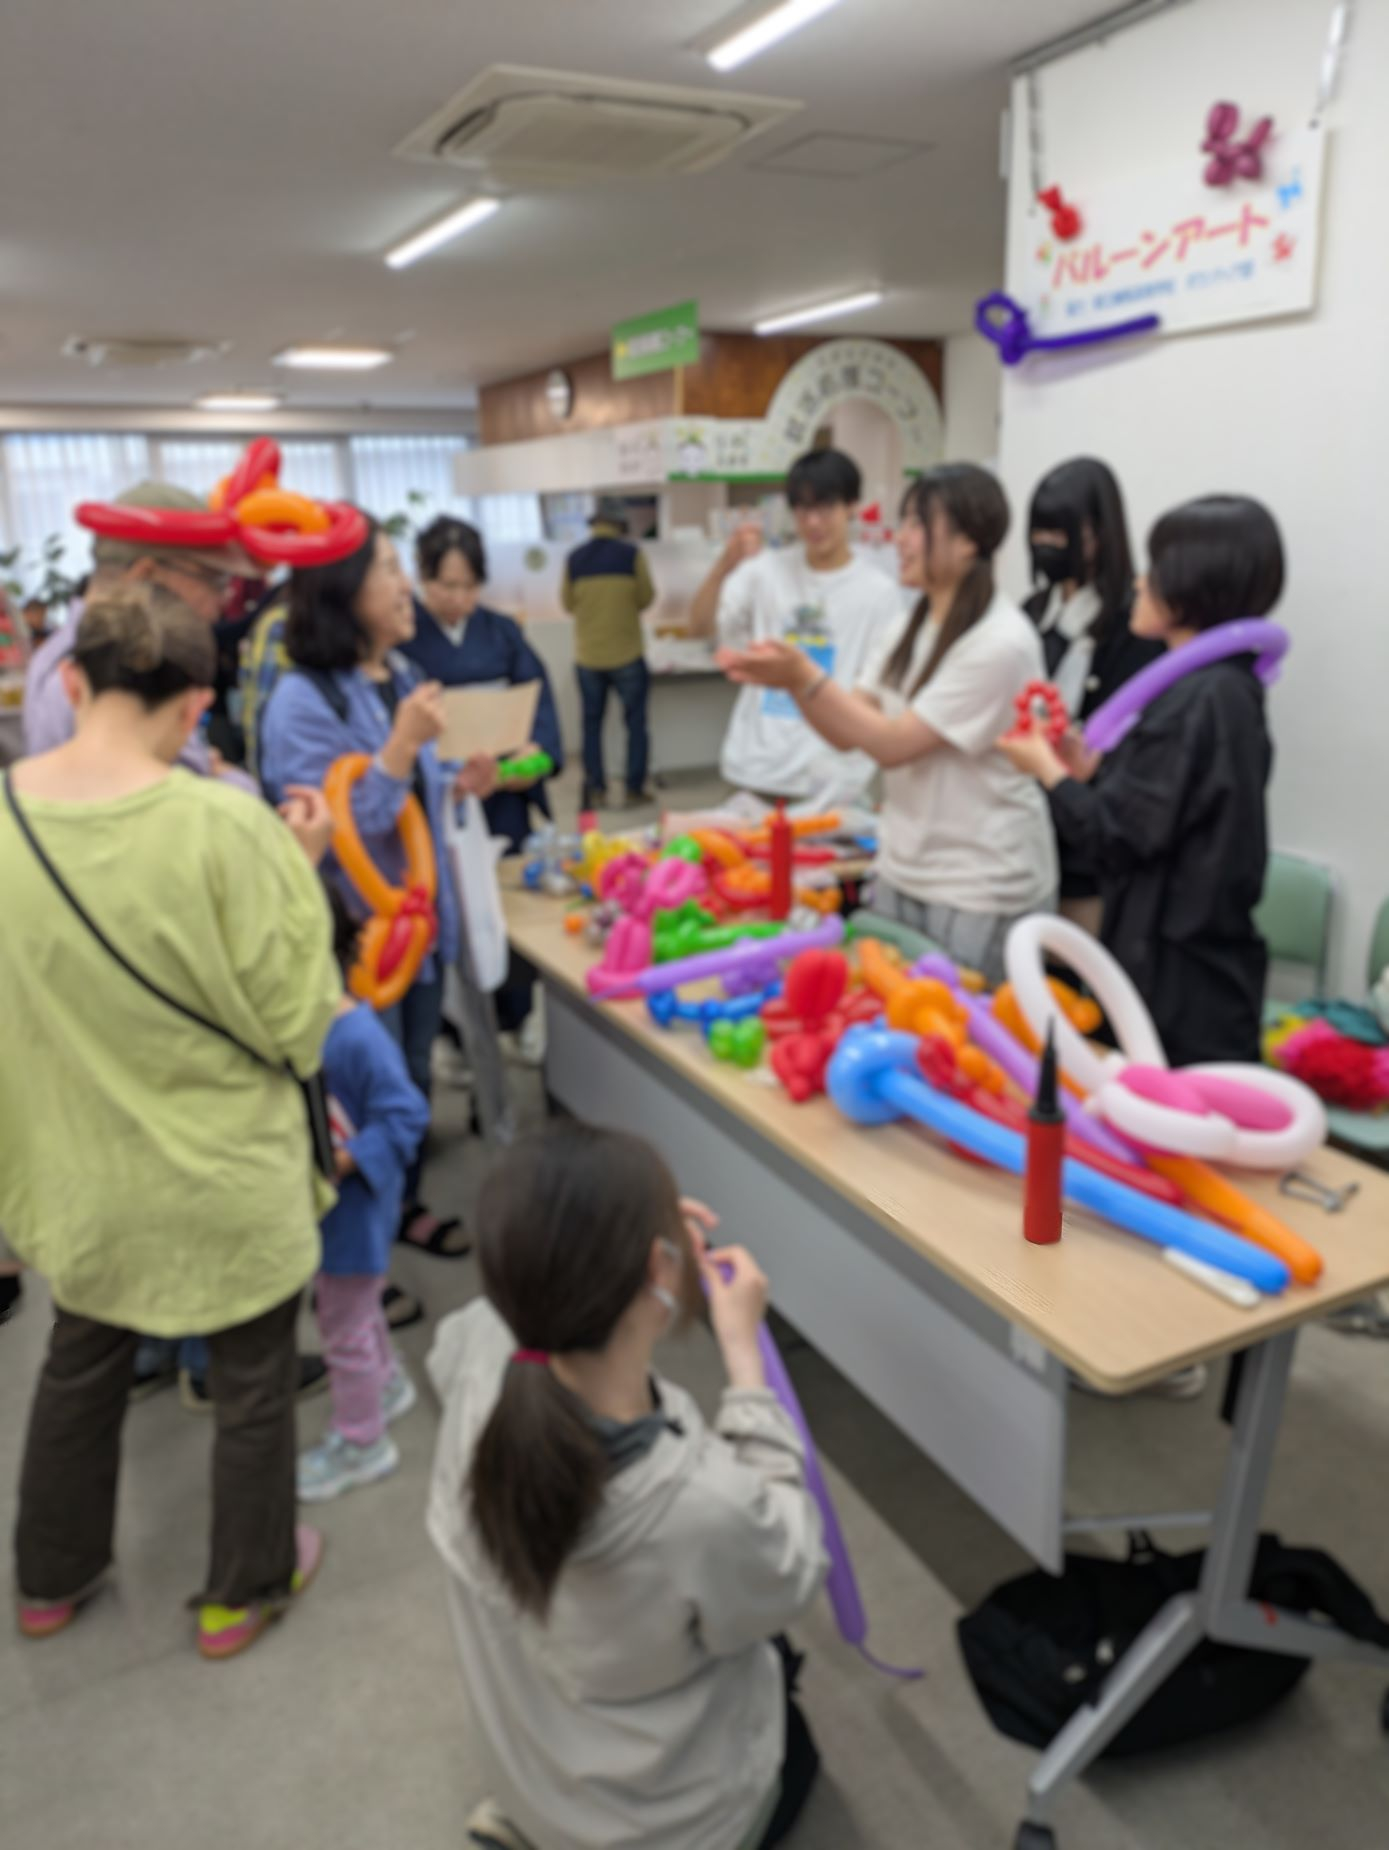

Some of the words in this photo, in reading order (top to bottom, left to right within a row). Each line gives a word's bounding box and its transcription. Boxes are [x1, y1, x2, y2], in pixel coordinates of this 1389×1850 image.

[1052, 204, 1269, 287] バルーンアート
